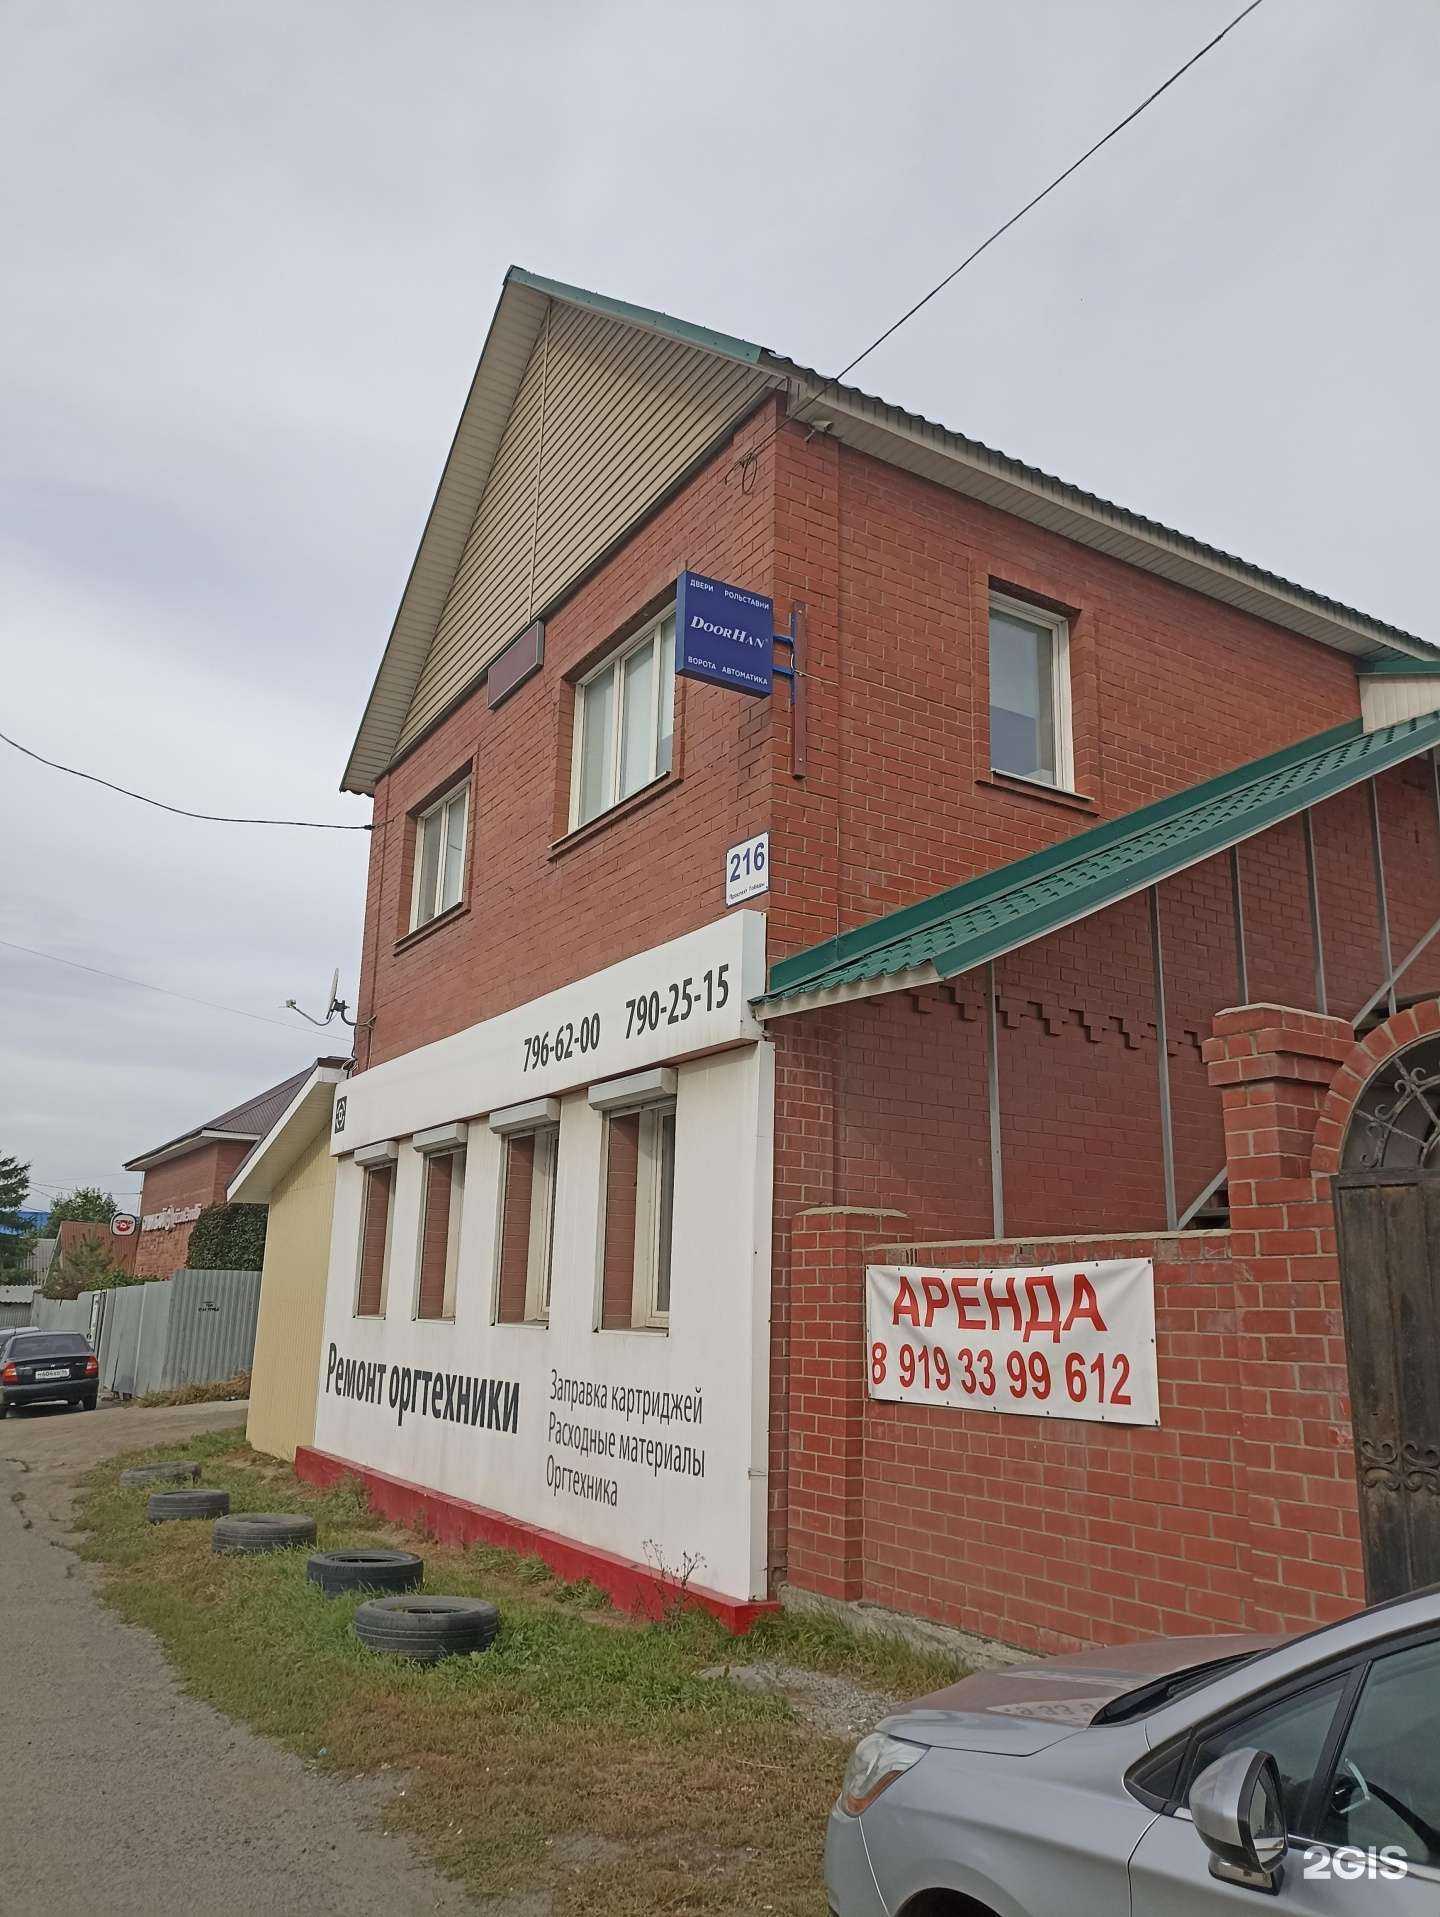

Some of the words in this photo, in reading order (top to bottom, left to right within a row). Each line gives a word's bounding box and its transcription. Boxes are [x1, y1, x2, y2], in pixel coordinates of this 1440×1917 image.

[690, 579, 714, 592] ДВЕРИ
[724, 590, 770, 610] РОЛЬСТАВНИ
[688, 655, 717, 670] ВОРОТА
[721, 666, 768, 686] АВТОМАТИКА
[730, 842, 765, 883] 216
[523, 1013, 600, 1073] 796-62-00
[625, 963, 729, 1040] 790-25-15
[892, 1273, 1108, 1343] АРЕНДА
[326, 1342, 387, 1405] Ремонт
[389, 1365, 520, 1434] оргтехники
[550, 1368, 608, 1411] Заправка
[611, 1386, 703, 1426] картриджей
[871, 1342, 887, 1385] 8
[899, 1343, 951, 1391] 919
[958, 1348, 996, 1396] 33
[1007, 1350, 1051, 1400] 99
[1065, 1352, 1132, 1405] 612
[548, 1411, 616, 1458] Расходные
[619, 1434, 705, 1478] материалы
[546, 1454, 618, 1507] Оргтехника
